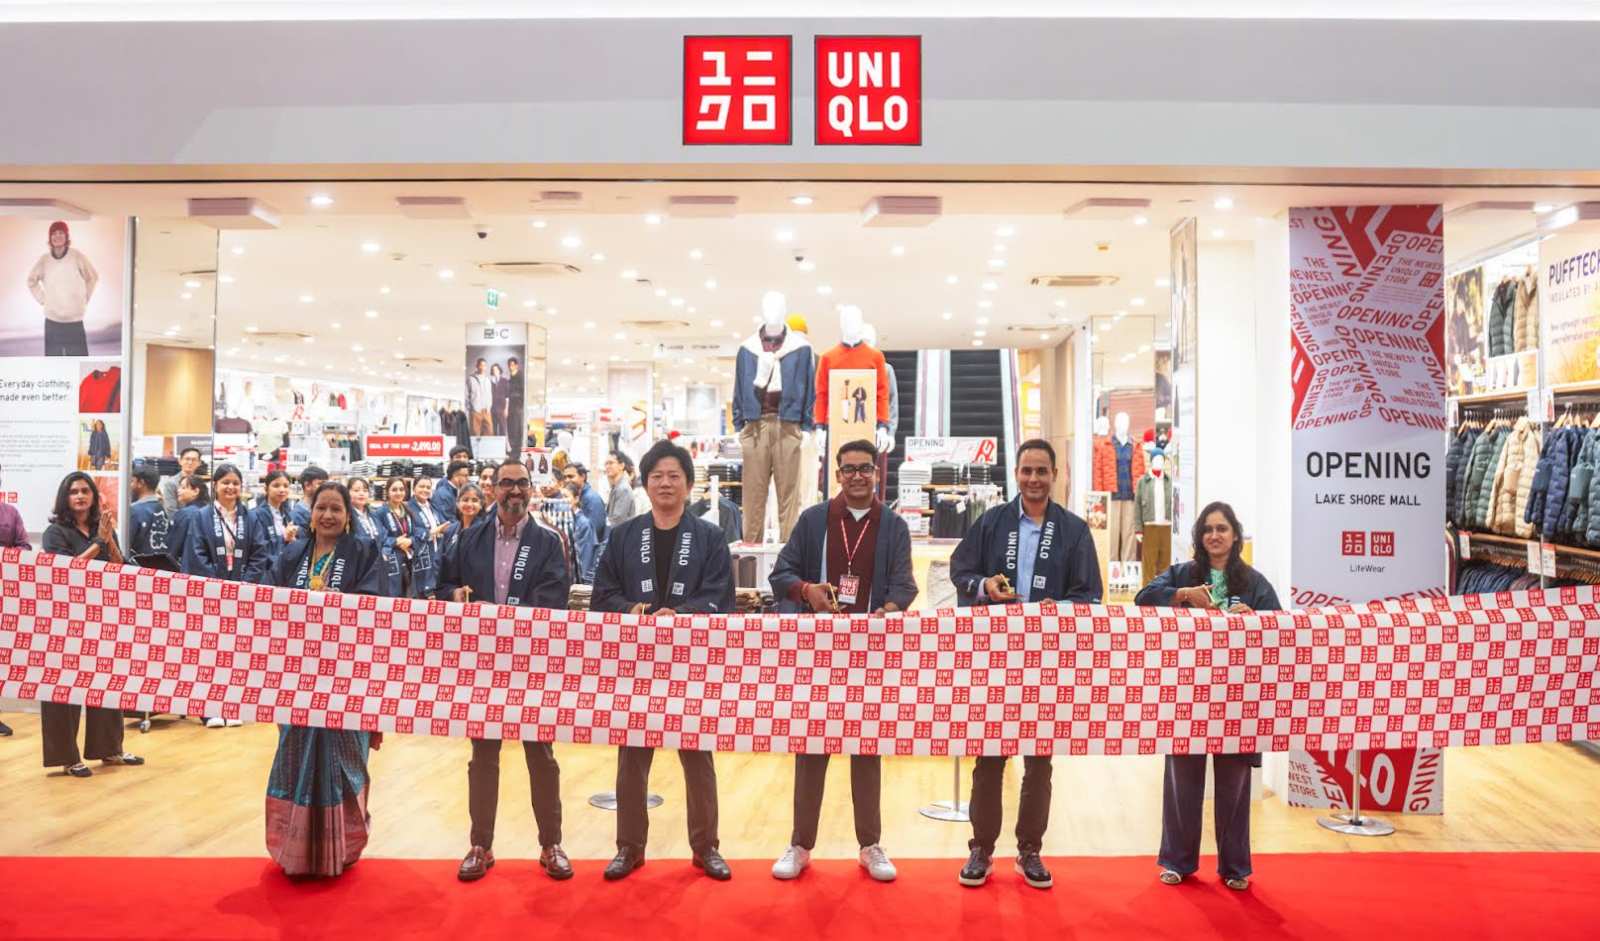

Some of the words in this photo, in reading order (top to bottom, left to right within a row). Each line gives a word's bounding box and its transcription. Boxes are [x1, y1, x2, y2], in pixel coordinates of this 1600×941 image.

[698, 51, 776, 86] ユニ
[828, 51, 901, 88] UNI
[695, 94, 776, 130] クロ
[828, 94, 909, 137] QLO
[1304, 256, 1328, 268] THE
[1348, 232, 1407, 303] OPENING
[1337, 305, 1413, 328] OPENING
[1353, 328, 1430, 353] OPENING
[1295, 410, 1358, 430] OPENING
[908, 438, 944, 448] OPENING
[1306, 451, 1431, 478] OPENING
[1315, 494, 1345, 504] LAKE
[1350, 494, 1385, 506] SHORE
[1390, 495, 1421, 506] MALL
[641, 528, 651, 564] UNIQLO
[678, 532, 692, 566] UNIQLO
[1006, 531, 1017, 569] UNIQLO
[1040, 521, 1054, 559] UNIQLO
[1373, 535, 1391, 543] UNI
[1373, 544, 1393, 554] QLO
[513, 545, 531, 580] UNIQLO
[1350, 564, 1386, 573] LifeWear
